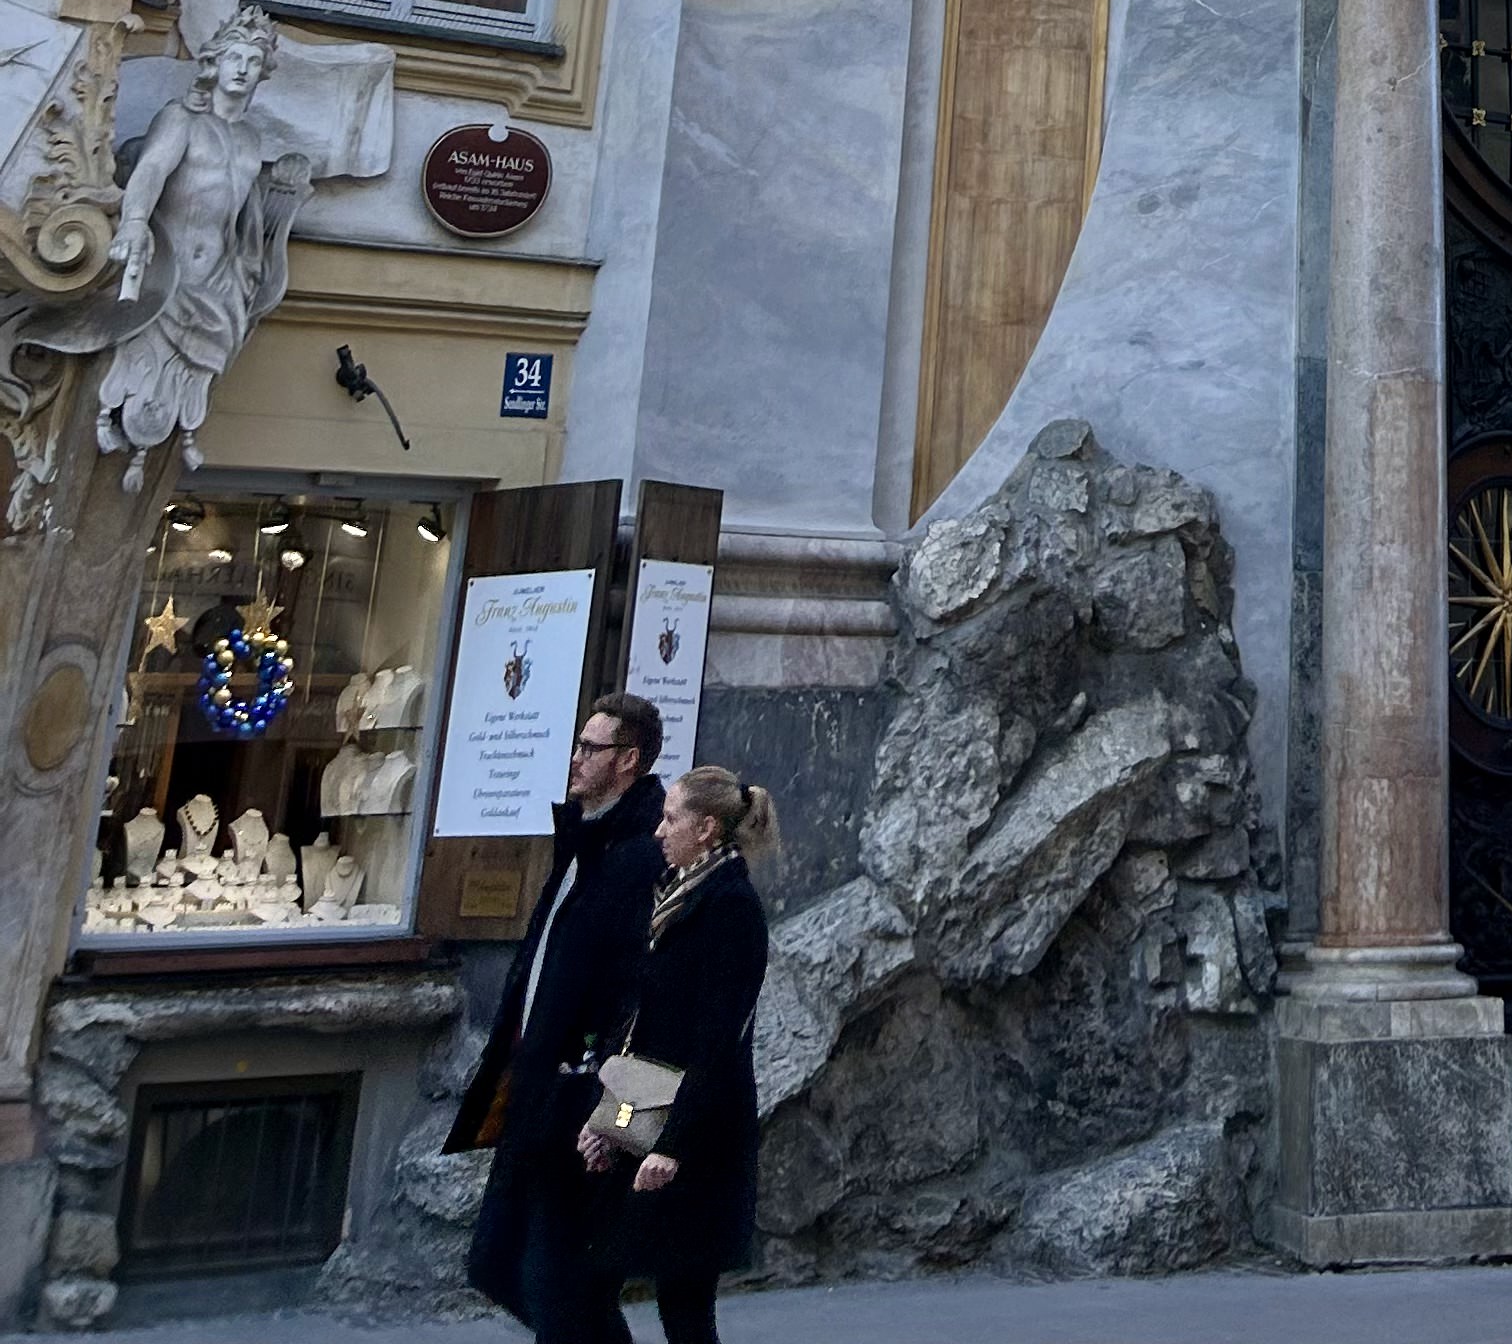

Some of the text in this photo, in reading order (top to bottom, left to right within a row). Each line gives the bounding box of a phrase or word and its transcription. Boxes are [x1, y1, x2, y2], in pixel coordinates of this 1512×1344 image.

[448, 150, 535, 172] ASAM-HAUS
[514, 358, 541, 386] 34
[475, 596, 578, 626] Franz Augustin
